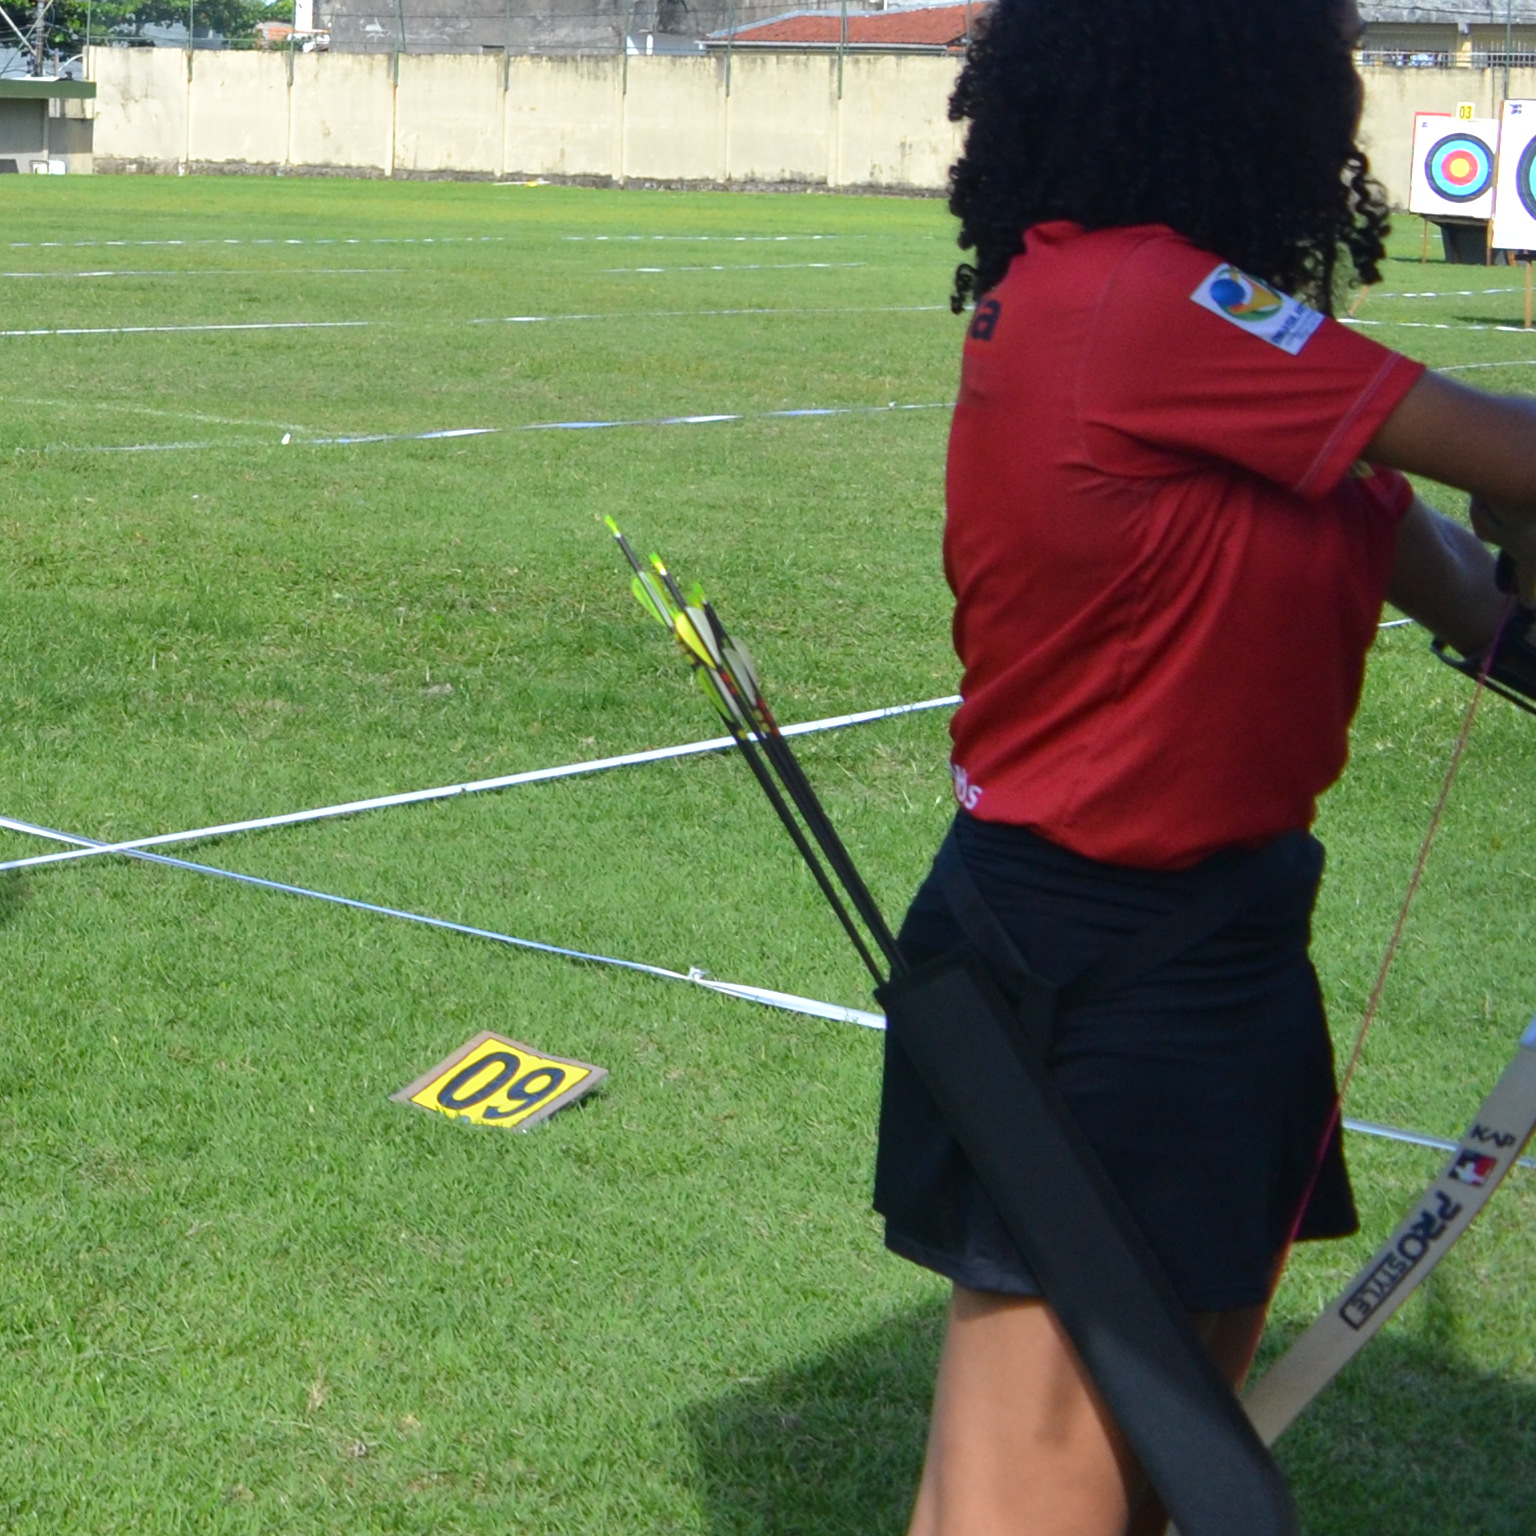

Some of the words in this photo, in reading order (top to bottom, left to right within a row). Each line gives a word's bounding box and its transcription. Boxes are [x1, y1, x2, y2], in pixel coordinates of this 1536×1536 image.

[1459, 105, 1473, 120] 03
[437, 1051, 566, 1120] 09
[1471, 1125, 1516, 1148] KAP
